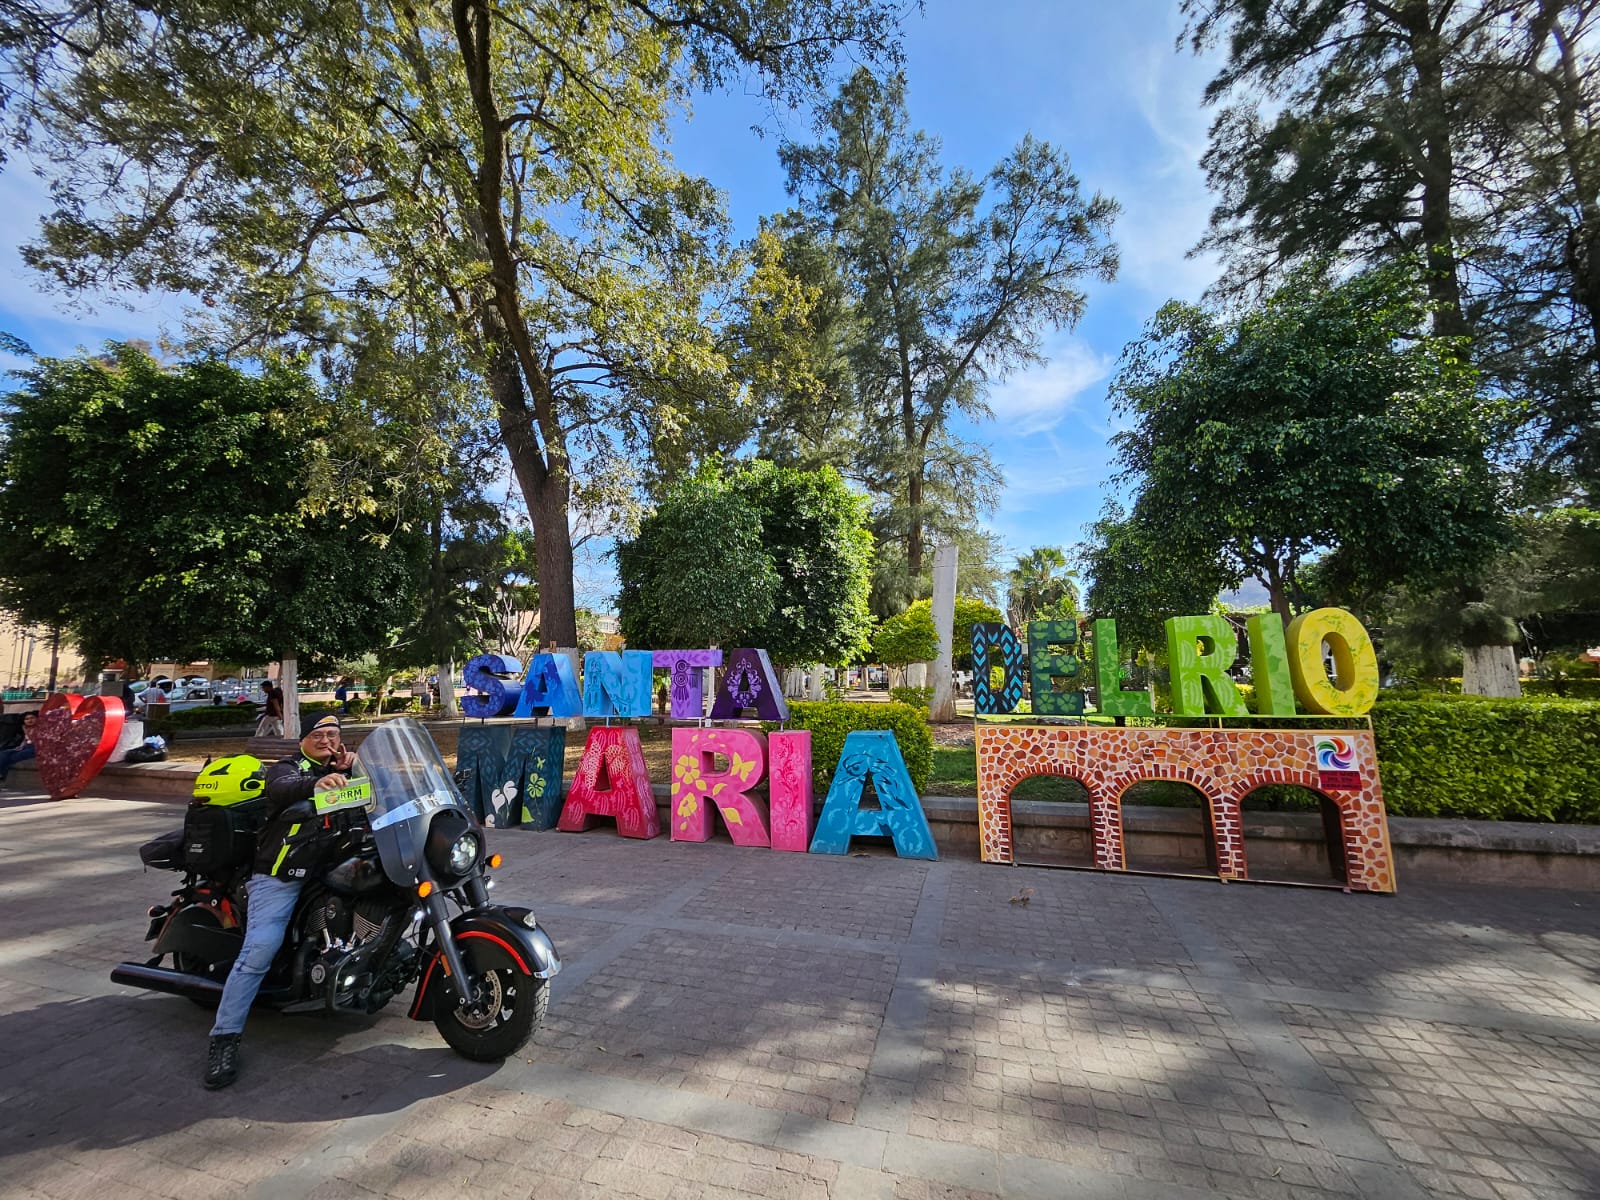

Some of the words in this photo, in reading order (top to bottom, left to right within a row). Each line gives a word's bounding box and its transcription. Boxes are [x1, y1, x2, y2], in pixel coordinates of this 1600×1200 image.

[461, 648, 790, 720] SANTA
[971, 618, 1154, 716] DEL
[1165, 607, 1380, 716] RIO
[340, 788, 362, 800] RRM
[456, 725, 939, 862] MARIA
